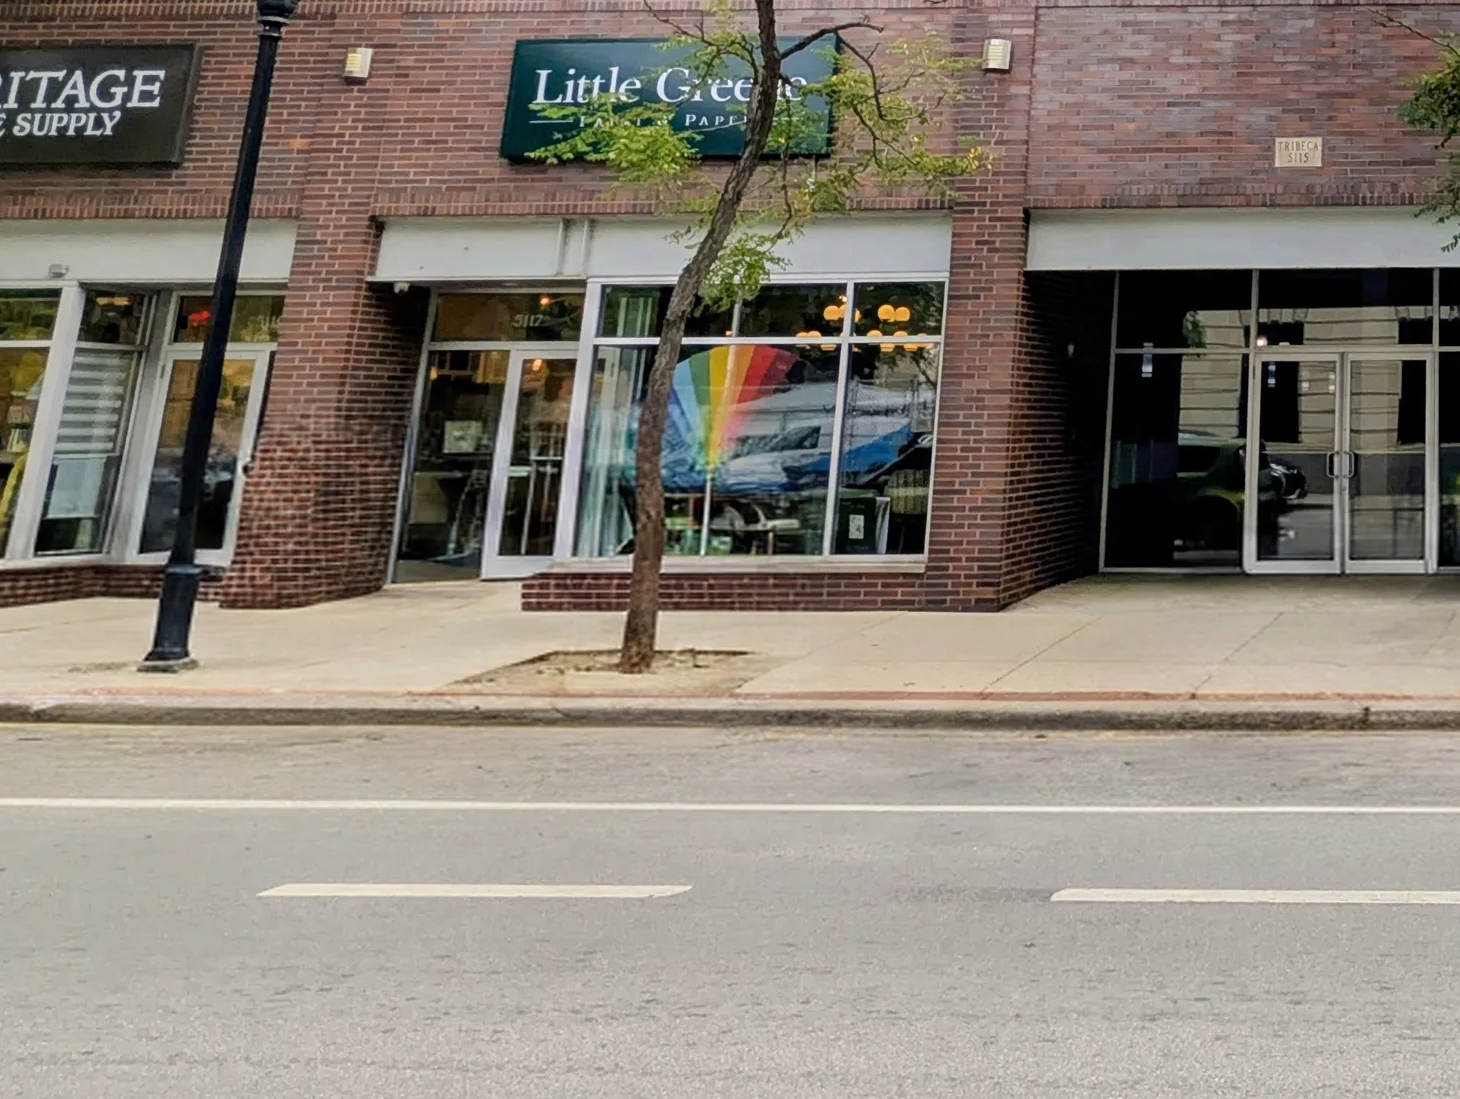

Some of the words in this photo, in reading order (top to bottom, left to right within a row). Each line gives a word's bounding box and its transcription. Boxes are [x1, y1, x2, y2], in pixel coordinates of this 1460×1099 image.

[531, 65, 642, 104] Little
[12, 110, 122, 137] SUPPLY
[685, 114, 748, 127] PAPE
[1278, 140, 1319, 152] TRIBECA
